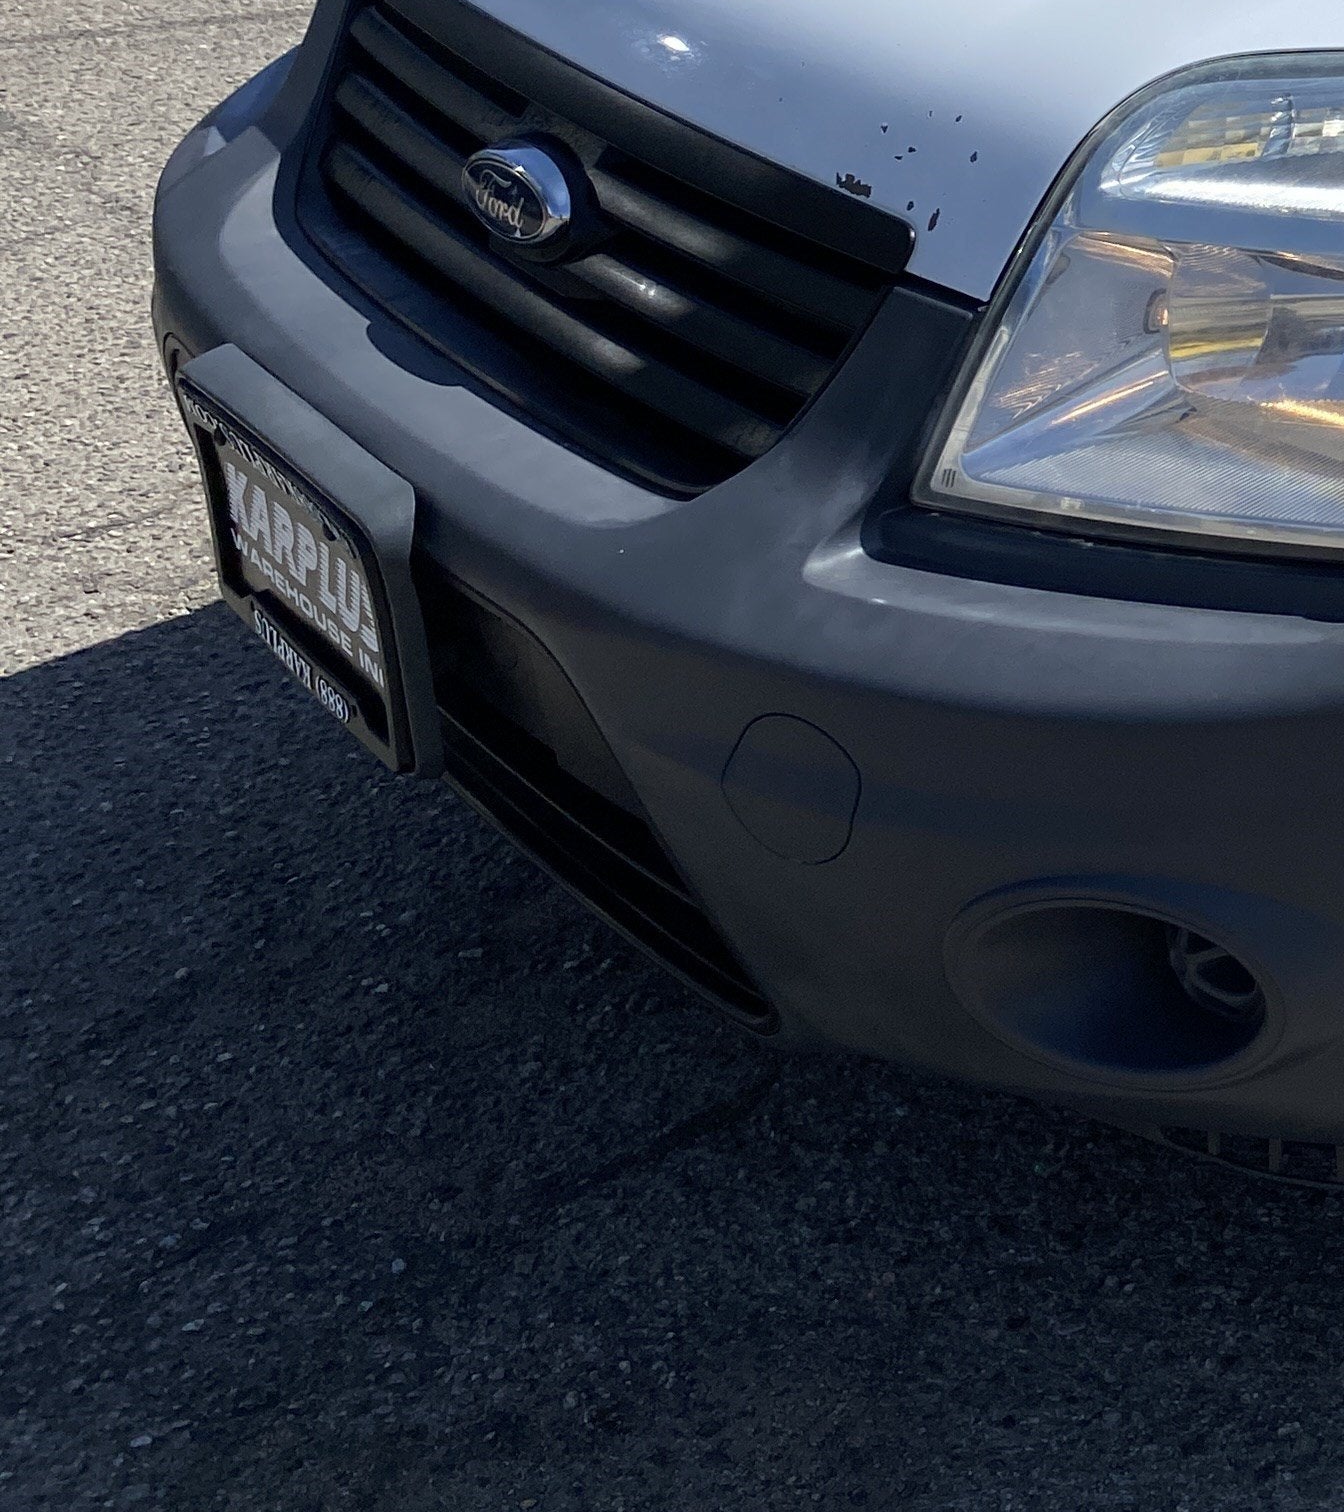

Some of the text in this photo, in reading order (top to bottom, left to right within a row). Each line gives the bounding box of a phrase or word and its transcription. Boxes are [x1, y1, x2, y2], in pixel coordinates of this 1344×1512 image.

[475, 169, 525, 229] Ford
[230, 527, 385, 689] WAREHOUSE IN
[254, 607, 352, 724] (888) KARPLUS
